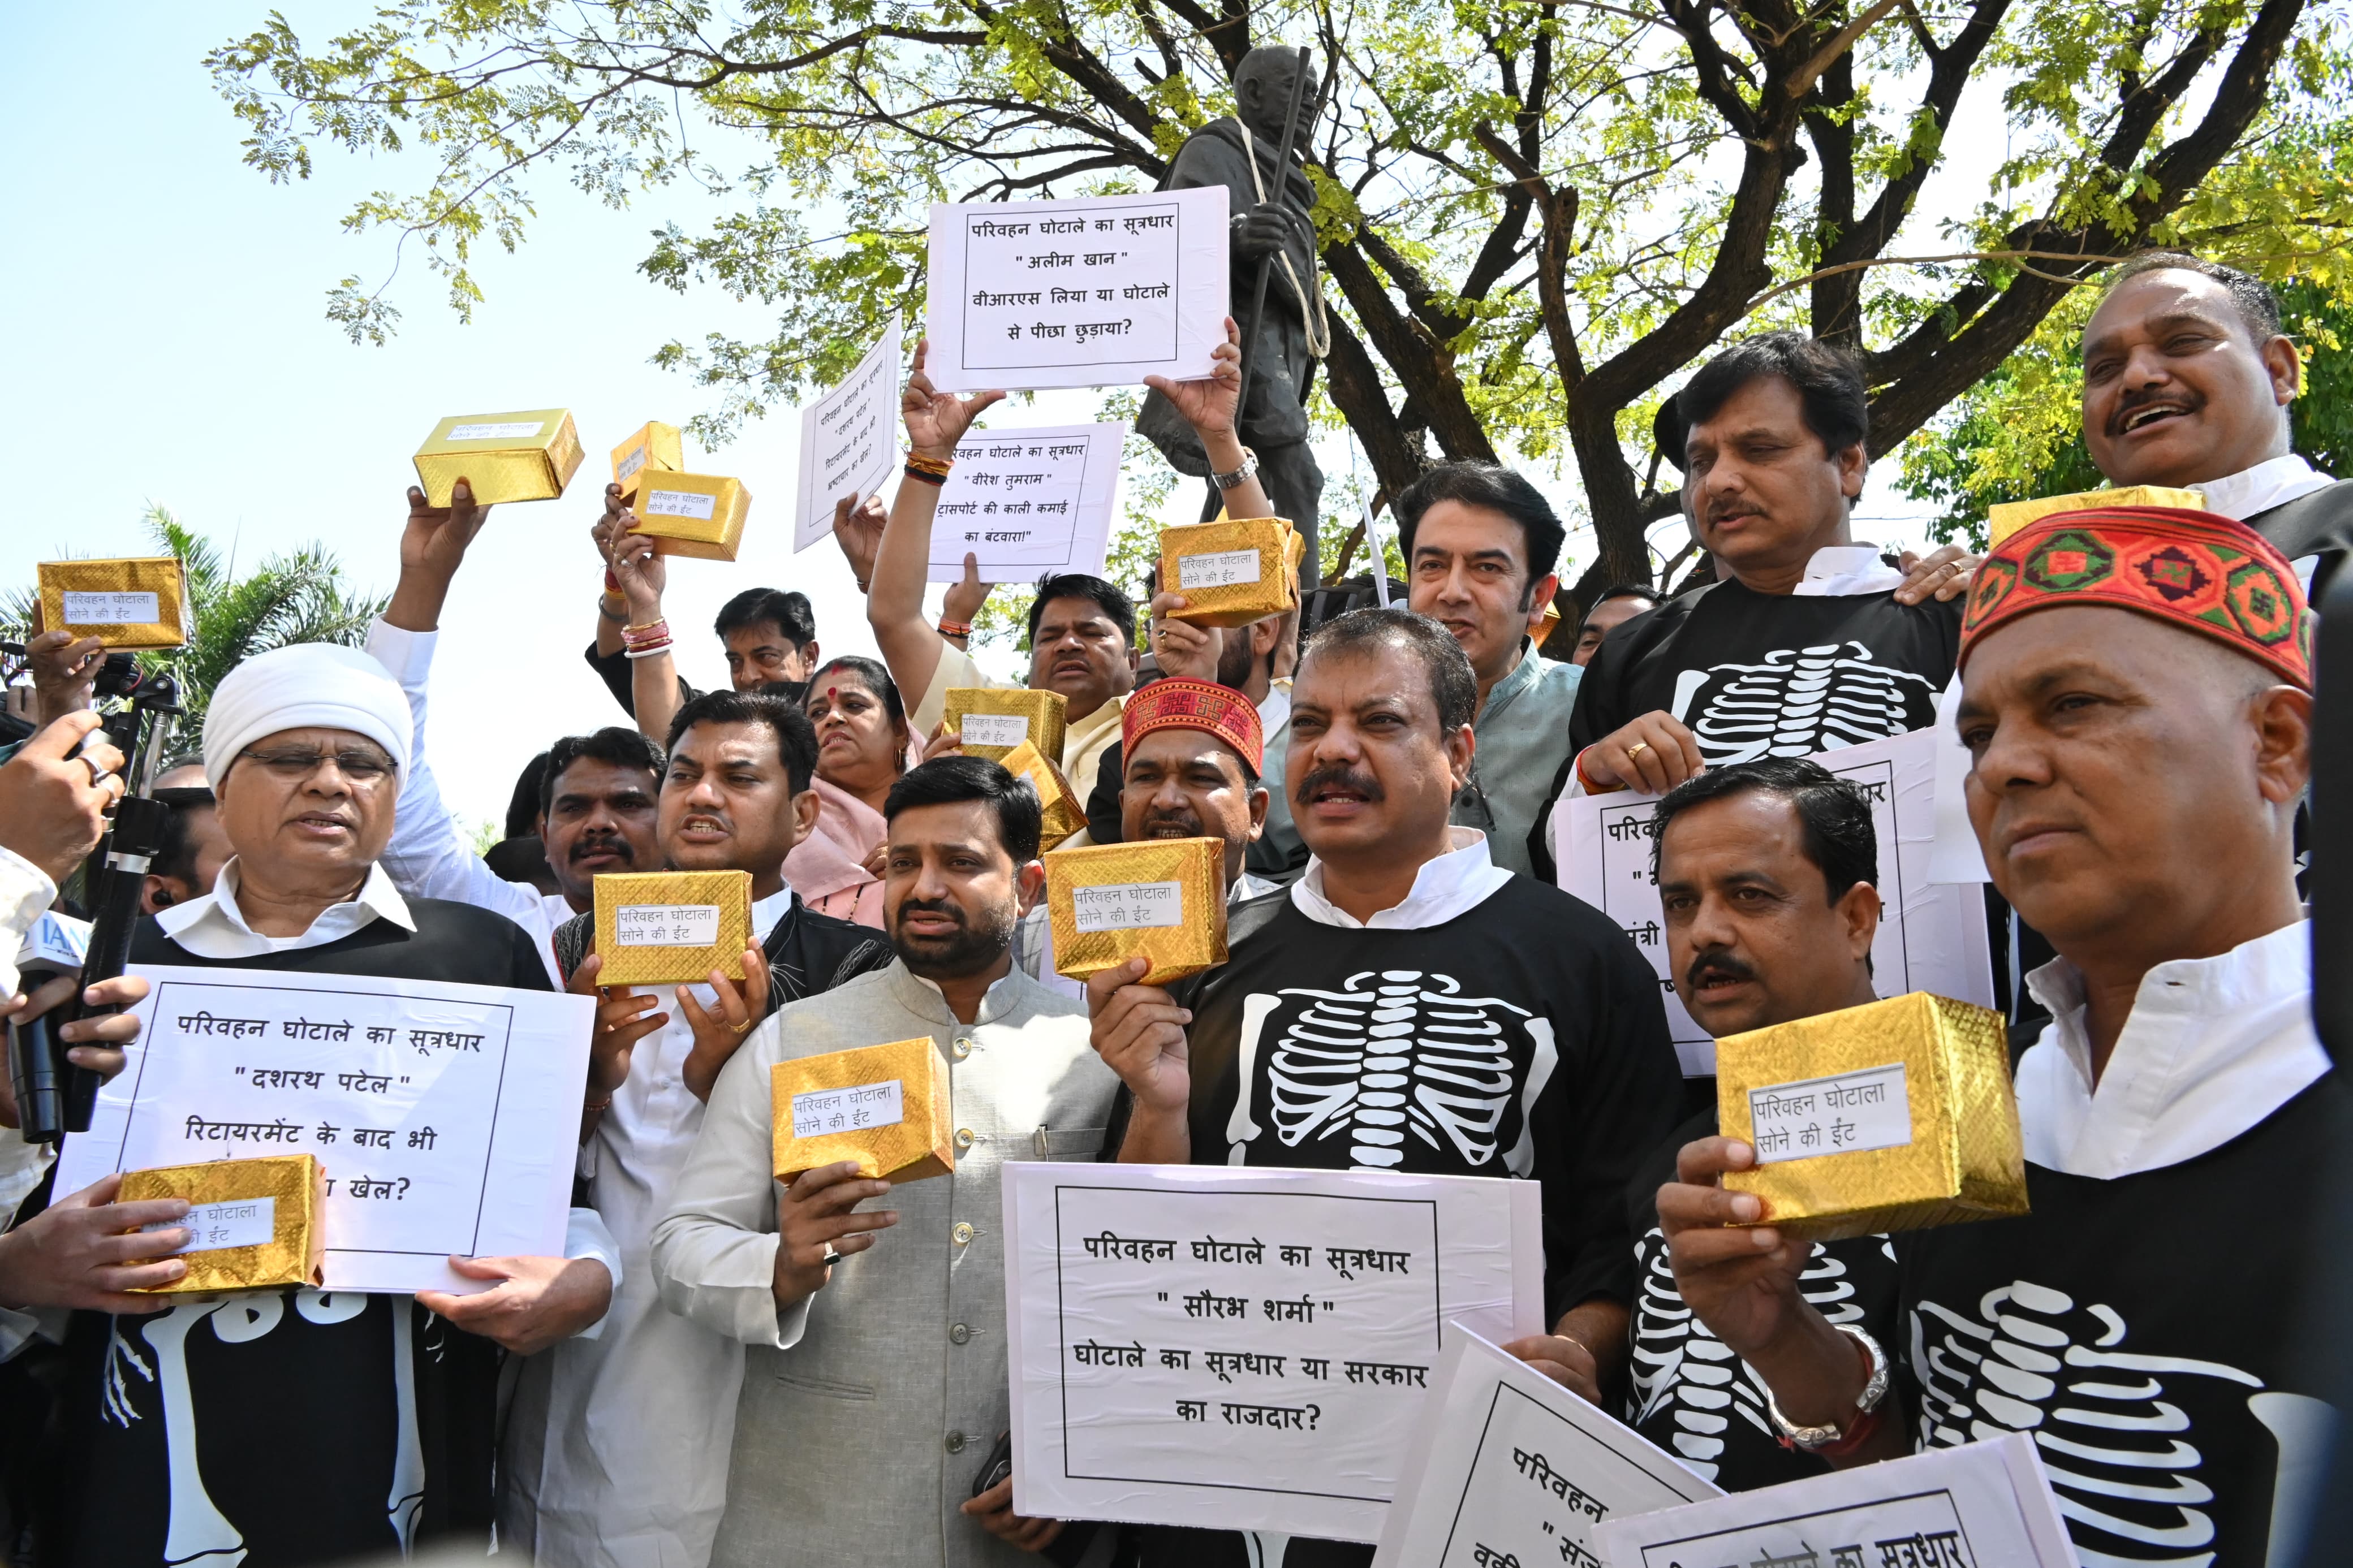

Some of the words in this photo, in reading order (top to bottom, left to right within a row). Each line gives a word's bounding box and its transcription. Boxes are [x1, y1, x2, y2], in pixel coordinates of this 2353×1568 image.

[972, 221, 1031, 237] परिवहन
[1040, 217, 1086, 234] घोटाले
[1095, 219, 1114, 231] का
[1123, 215, 1174, 235] सूत्रधार
[973, 291, 1041, 306] वीआरएस
[1050, 287, 1087, 303] लिया
[1096, 290, 1114, 301] या
[1123, 282, 1170, 299] घोटाले
[1008, 324, 1022, 340] से
[1031, 322, 1066, 338] पीछा
[1075, 319, 1131, 343] छुड़ाया?
[821, 404, 842, 425] परिवहन
[844, 387, 859, 407] घोटाले
[861, 379, 867, 391] का
[869, 360, 883, 385] सूत्रधार
[826, 443, 851, 470] रिटायरमेंट
[853, 437, 857, 446] के
[870, 416, 876, 427] भी
[953, 448, 983, 460] रवहन
[990, 444, 1023, 458] घोटाले
[1028, 447, 1042, 457] का
[1049, 444, 1085, 460] सूत्रधार
[851, 460, 857, 470] का
[860, 443, 871, 464] खेल?
[649, 502, 663, 512] सोने
[680, 505, 692, 515] ईंट
[651, 491, 678, 502] परिवहन
[683, 494, 708, 504] घोटाला
[938, 500, 978, 517] ट्रांसपोर्ट
[984, 502, 997, 515] की
[1004, 500, 1031, 515] काली
[1037, 499, 1068, 515] कमाई
[965, 532, 979, 542] का
[1180, 558, 1214, 570] परिवहन
[1219, 553, 1252, 565] घोटाला
[1182, 573, 1200, 585] सोने
[1205, 572, 1217, 582] की
[1222, 569, 1235, 581] ईंट
[67, 593, 106, 605] परिवहन
[113, 593, 149, 604] घोटाला
[67, 608, 89, 620] सोने
[96, 608, 109, 619] की
[115, 607, 131, 620] ईंट
[963, 715, 990, 727] परिवहन
[994, 716, 1022, 729] घोटाला
[962, 730, 977, 741] सोने
[981, 731, 990, 741] की
[994, 731, 1005, 743] ईंट
[1074, 888, 1121, 904] परिवहन
[1128, 884, 1171, 900] घोटाला
[620, 909, 663, 923] परिवहन
[671, 907, 712, 921] घोटाला
[1077, 909, 1102, 925] सोने
[1111, 907, 1126, 923] की
[1132, 905, 1151, 923] ईंट
[620, 927, 644, 941] सोने
[652, 926, 666, 940] की
[673, 925, 689, 941] ईंट
[178, 1011, 270, 1039] परिवहन
[283, 1017, 354, 1042] घोटाले
[367, 1027, 397, 1044] का
[409, 1030, 485, 1056] सूत्रधार
[793, 1095, 841, 1113] परिवहन
[848, 1086, 891, 1104] घोटाला
[1754, 1093, 1815, 1120] परिवहन
[1824, 1082, 1885, 1109] घोटाला
[186, 1115, 304, 1142] रिटायरमेंट
[317, 1121, 341, 1144] के
[354, 1129, 395, 1150] बाद
[408, 1126, 437, 1150] भी
[795, 1116, 821, 1134] सोने
[828, 1113, 844, 1129] की
[852, 1109, 870, 1126] ईंट
[1757, 1126, 1790, 1154] सोने
[1800, 1124, 1821, 1148] की
[1830, 1117, 1856, 1147] ईंट
[350, 1175, 410, 1200] खेल?
[207, 1204, 257, 1221] घोटाला
[209, 1226, 230, 1244] ईंट
[1083, 1230, 1177, 1263] परिवहन
[1191, 1235, 1265, 1264] घोटाले
[1279, 1246, 1312, 1267] का
[1326, 1248, 1411, 1280] सूत्रधार
[1183, 1289, 1248, 1319] सौरभ
[1074, 1339, 1146, 1367] घोटाले
[1160, 1349, 1191, 1370] का
[1205, 1352, 1287, 1383] सूत्रधार
[1300, 1358, 1330, 1380] या
[1344, 1362, 1429, 1388] सरकार
[1176, 1400, 1207, 1422] का
[1221, 1403, 1320, 1430] राजदार?
[1513, 1447, 1609, 1523] परिवहन
